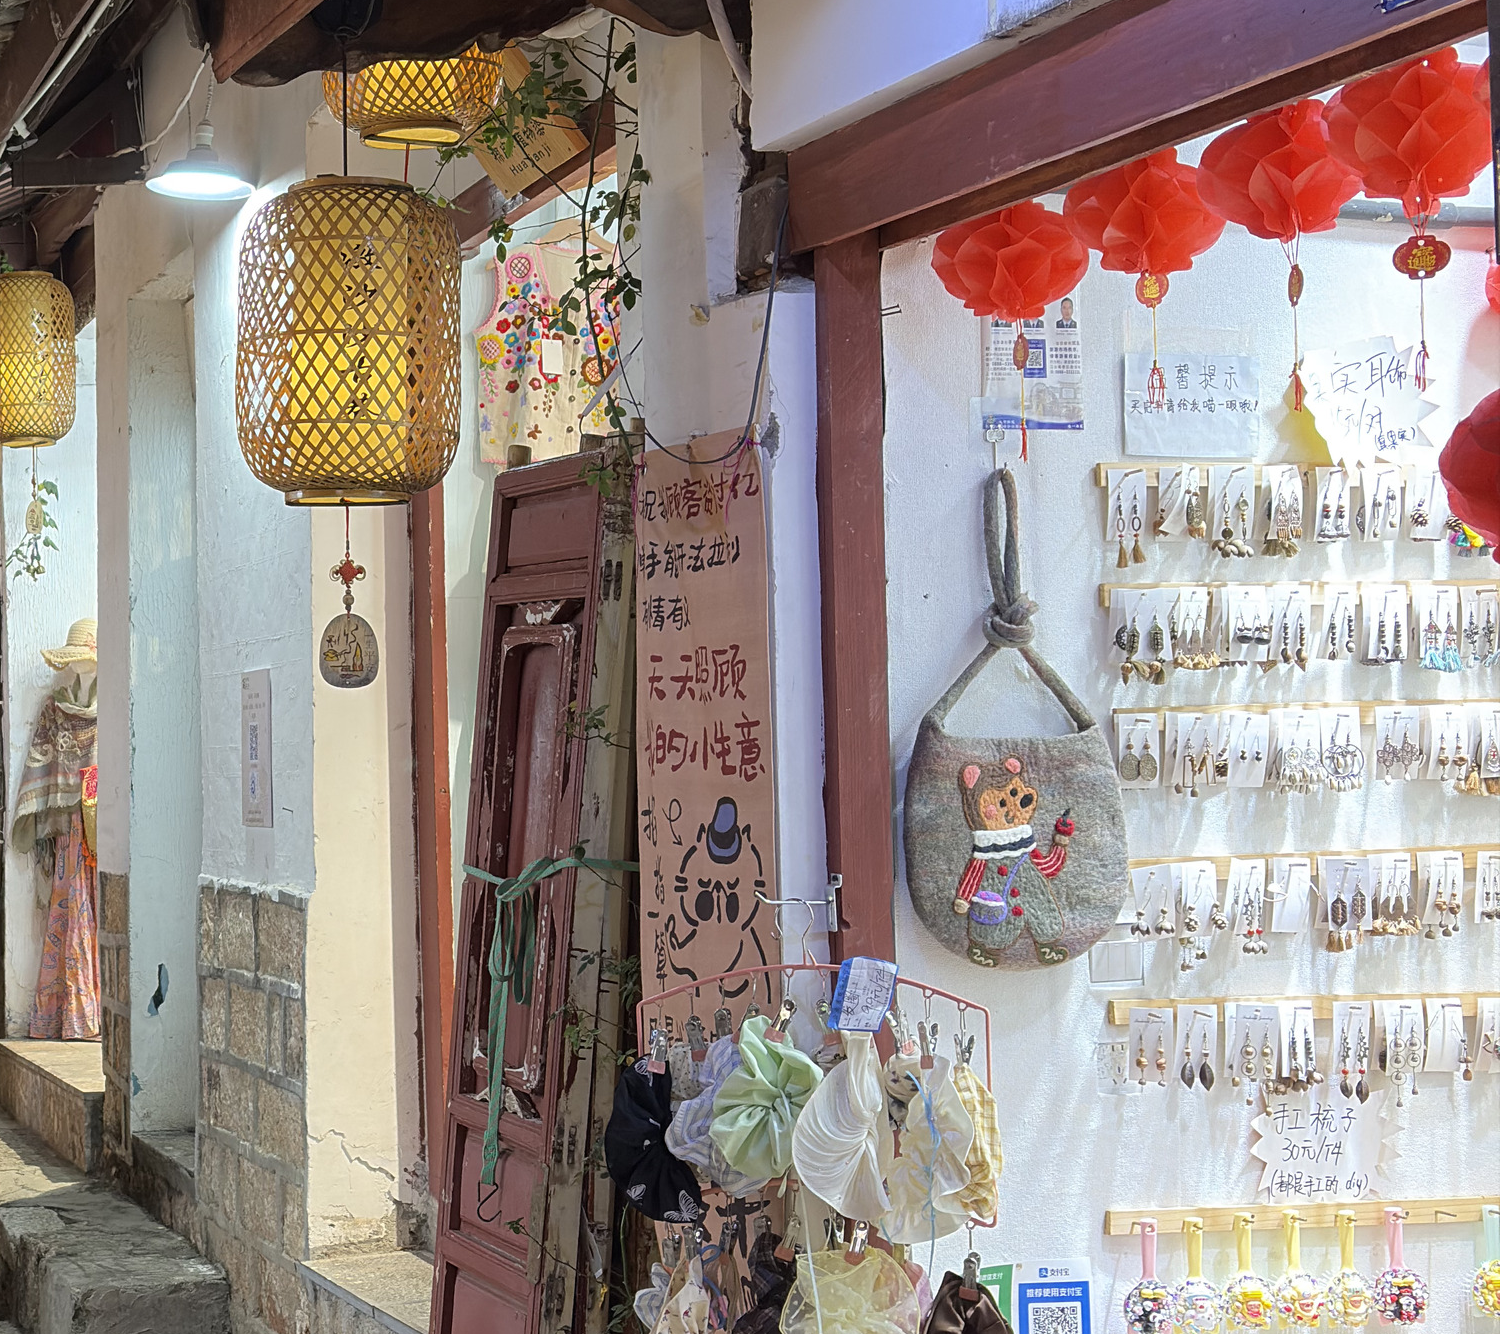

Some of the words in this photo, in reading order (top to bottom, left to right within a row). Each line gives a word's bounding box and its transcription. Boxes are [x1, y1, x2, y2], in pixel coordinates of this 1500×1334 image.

[648, 644, 747, 706] 天天照顾
[645, 711, 766, 782] 我的小生意
[1273, 1102, 1357, 1135] 手工梳子
[1281, 1139, 1343, 1165] 30元/件
[980, 1272, 1004, 1282] 微信支付
[1049, 1267, 1070, 1277] 支付宝
[1026, 1287, 1083, 1298] 推荐使用支付宝
